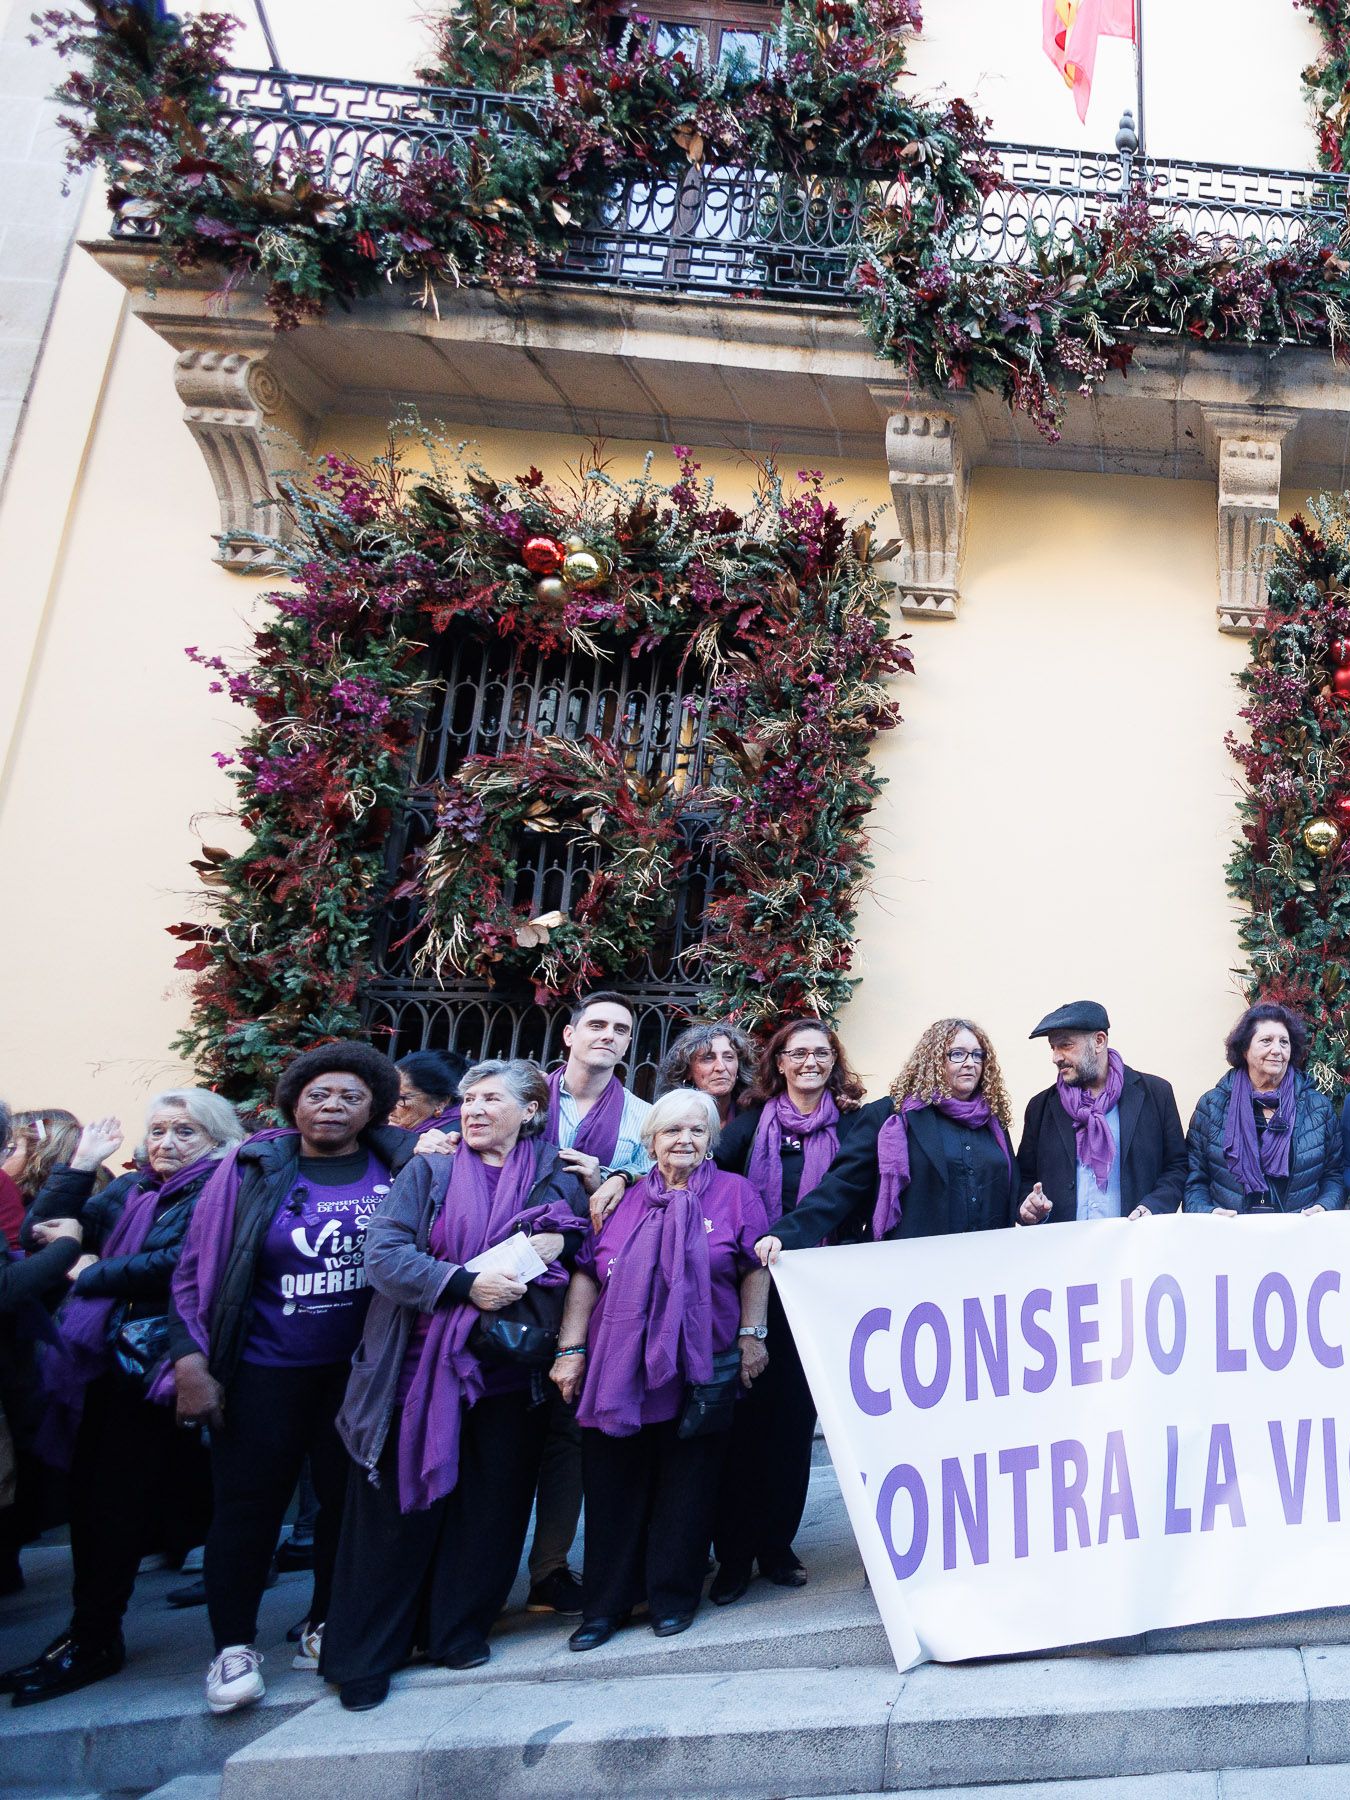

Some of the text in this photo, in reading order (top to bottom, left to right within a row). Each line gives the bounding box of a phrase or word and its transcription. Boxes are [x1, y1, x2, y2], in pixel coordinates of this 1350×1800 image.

[317, 1199, 360, 1208] CONSEJO
[317, 1205, 333, 1213] DE
[335, 1204, 350, 1212] LA
[848, 1274, 1187, 1417] CONSEJO
[861, 1430, 1140, 1581] ONTRA
[1164, 1423, 1246, 1536] LA
